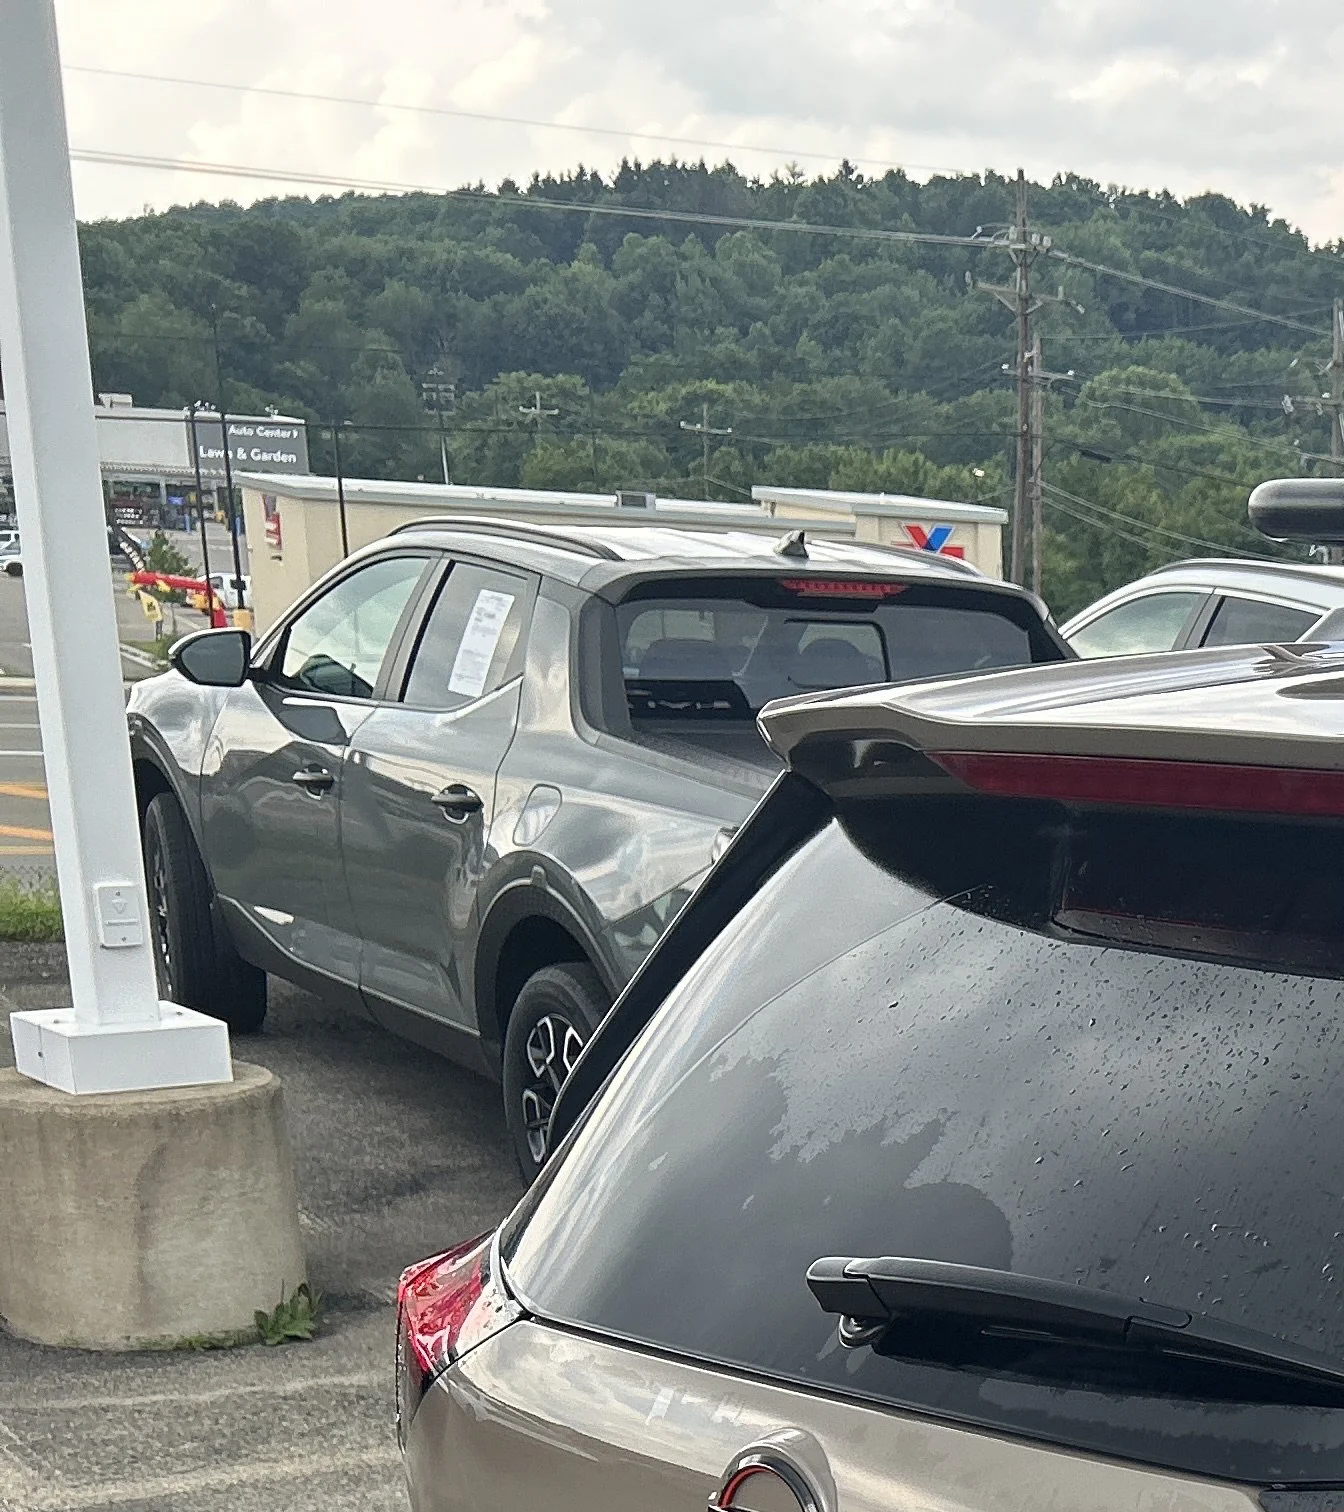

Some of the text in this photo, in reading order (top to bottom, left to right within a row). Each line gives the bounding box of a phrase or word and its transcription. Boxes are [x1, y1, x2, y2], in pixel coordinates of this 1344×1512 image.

[228, 425, 291, 438] Auto Center
[237, 447, 247, 460] &
[250, 448, 297, 463] Garden
